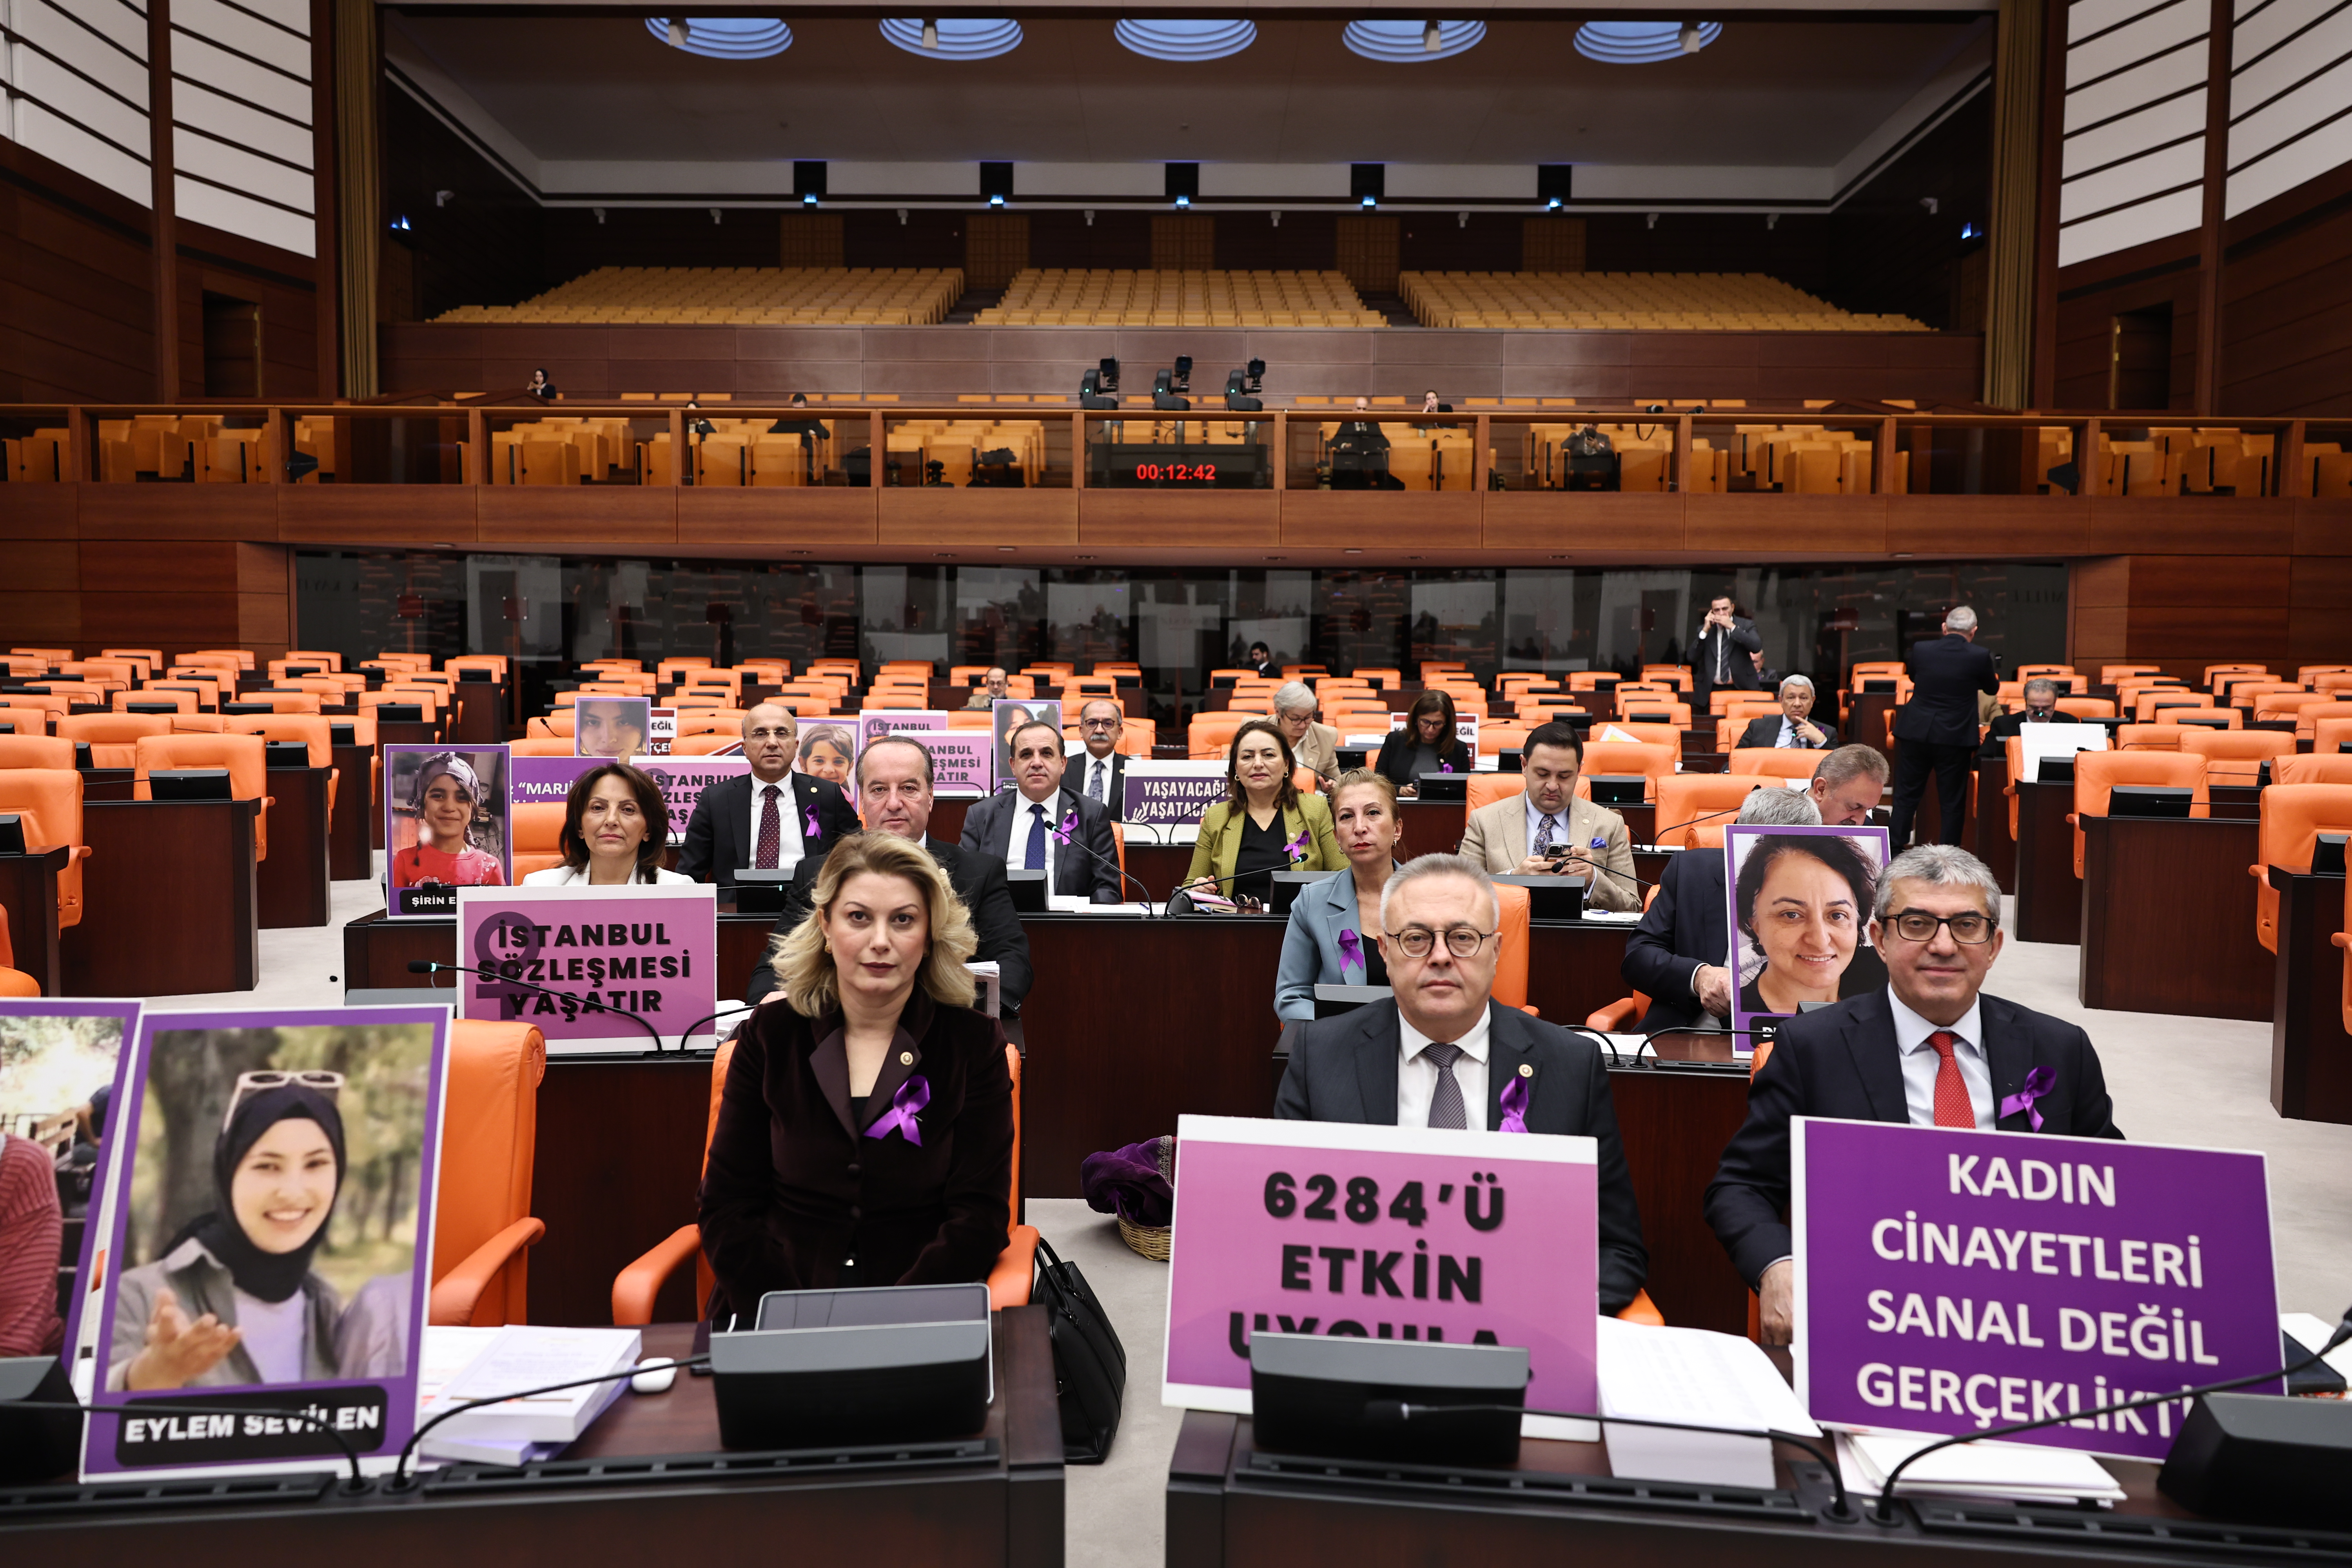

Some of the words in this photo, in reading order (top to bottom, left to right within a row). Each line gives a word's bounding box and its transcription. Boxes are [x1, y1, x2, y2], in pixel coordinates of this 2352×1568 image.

[1136, 464, 1216, 480] 00:12:42
[873, 720, 931, 730] İSTANBUL
[412, 895, 445, 907] ŞİRİN
[499, 919, 670, 948] İSTANBUL
[477, 949, 691, 988] SÖZLEŞMESİ
[508, 989, 662, 1023] YAŞATIR
[1949, 1154, 2116, 1207] KADIN
[1871, 1210, 2203, 1288] CİNAYETLERİ
[1281, 1239, 1482, 1303] ETKİN
[1867, 1290, 2044, 1348] SANAL
[2059, 1303, 2219, 1365] DEĞİL
[125, 1414, 235, 1443] EYLEM
